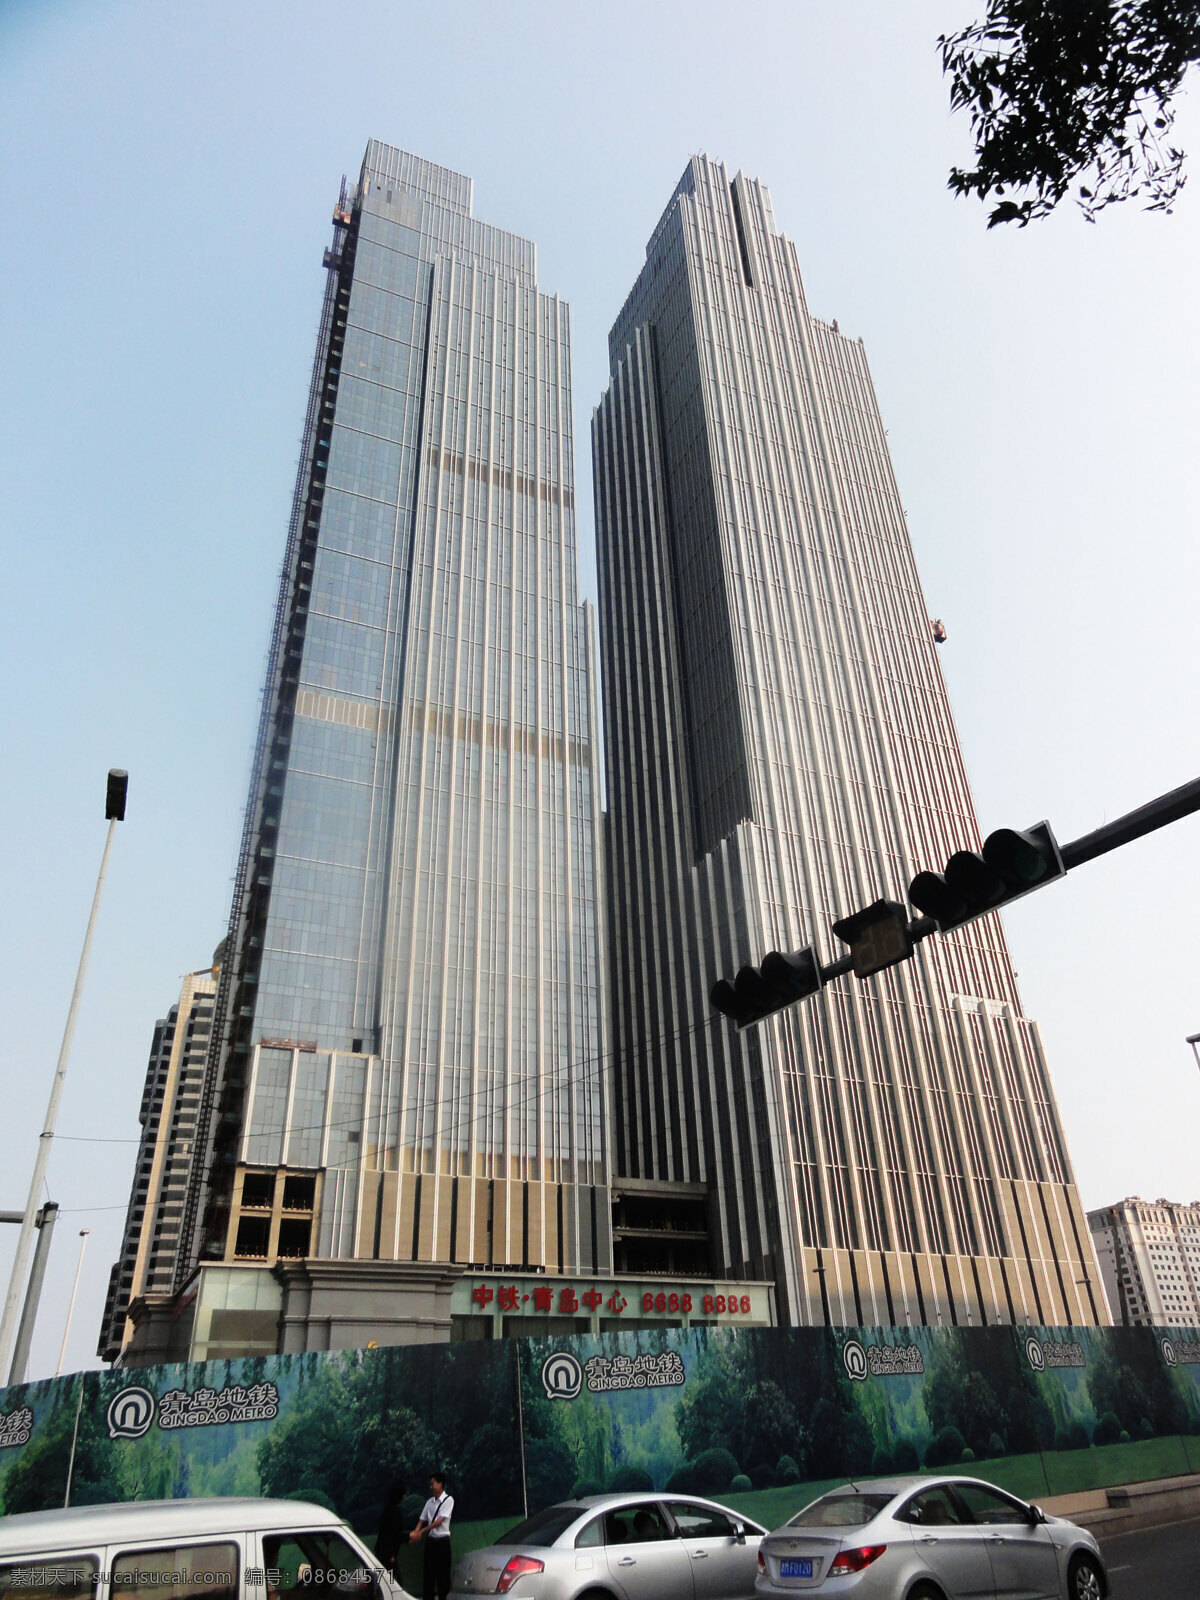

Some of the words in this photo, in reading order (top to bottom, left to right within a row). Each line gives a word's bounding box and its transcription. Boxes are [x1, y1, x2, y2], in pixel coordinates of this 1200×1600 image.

[473, 1284, 628, 1314] 中铁·青岛中心
[642, 1292, 692, 1313] 6688
[585, 1352, 684, 1378] 青岛地铁
[868, 1346, 922, 1364] 青岛地铁
[588, 1374, 645, 1390] QINGDAO
[647, 1371, 685, 1386] METRO
[159, 1383, 278, 1414] 青岛地铁
[0, 1408, 33, 1433] 铁
[159, 1412, 229, 1429] QINGDAO
[230, 1404, 278, 1422] METRO
[0, 1430, 30, 1447] ETRO
